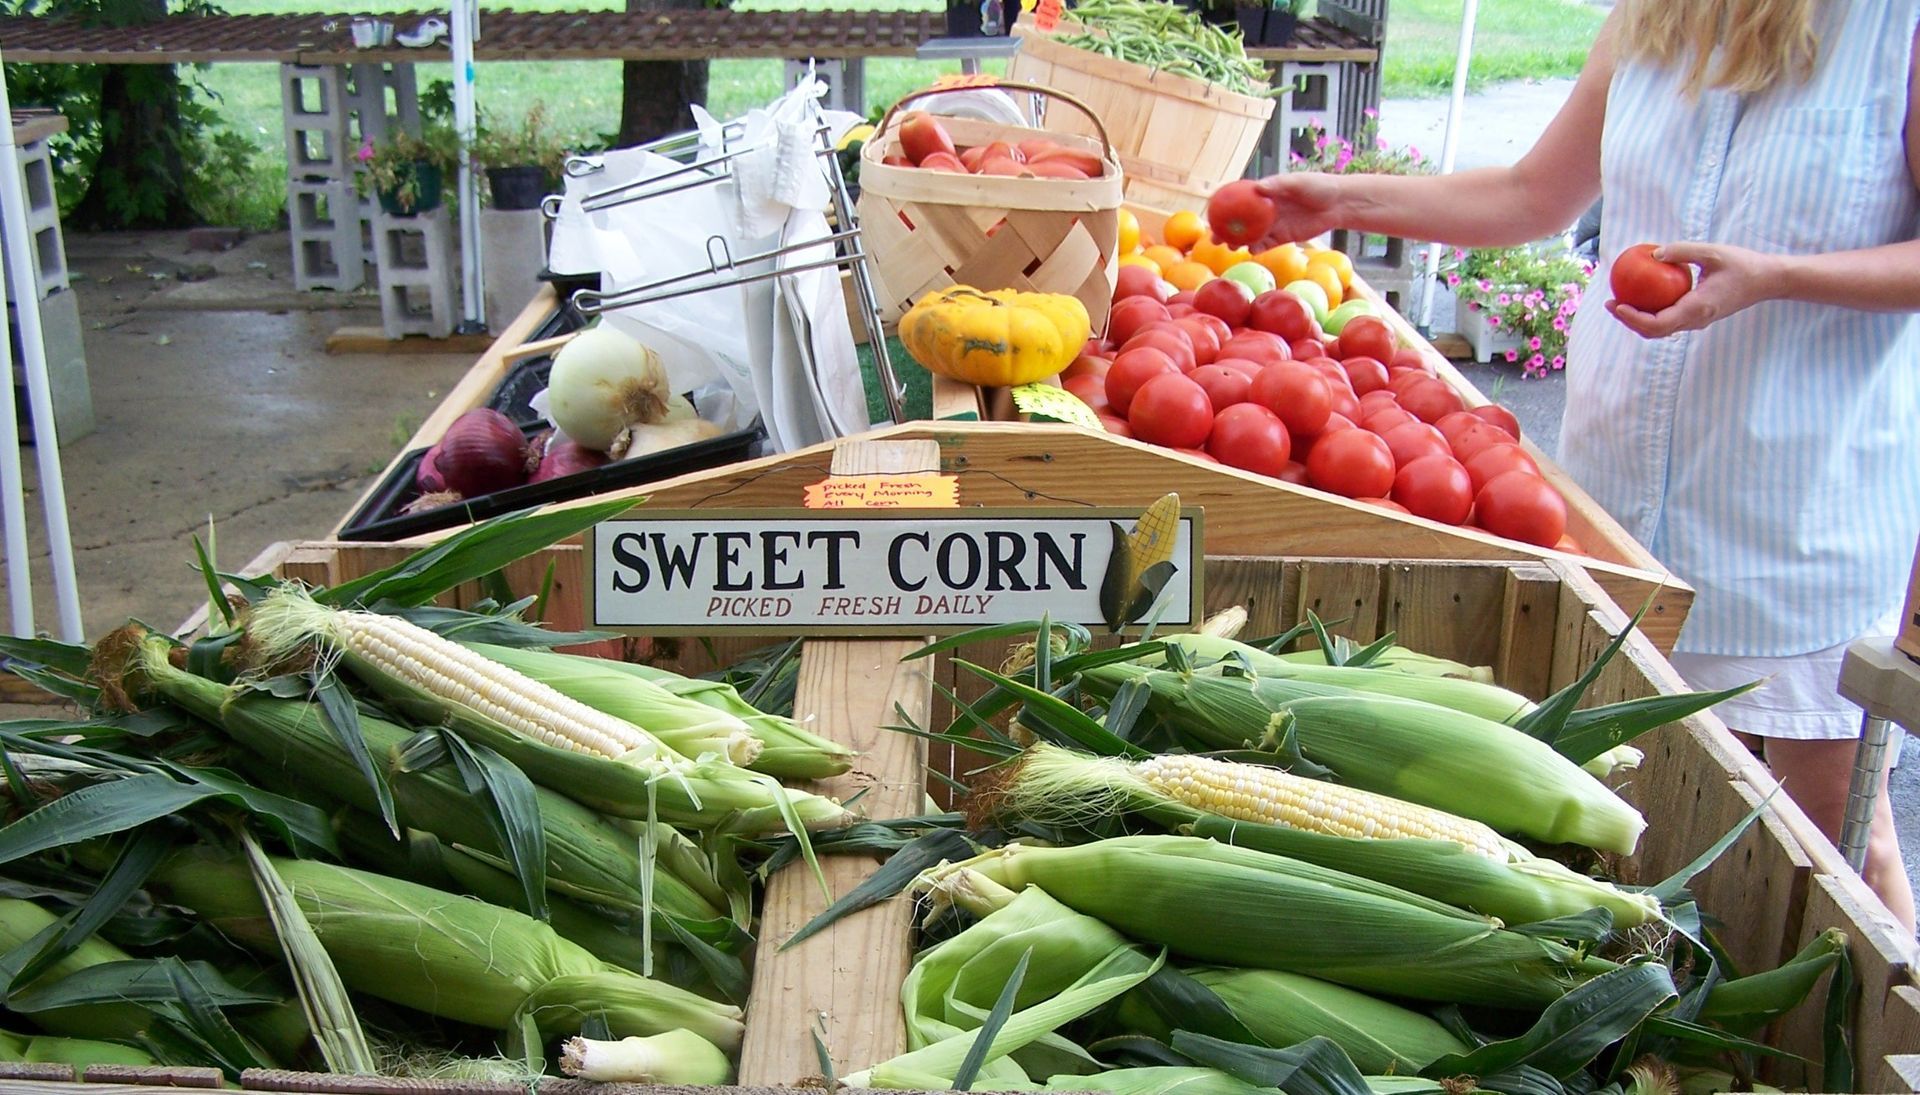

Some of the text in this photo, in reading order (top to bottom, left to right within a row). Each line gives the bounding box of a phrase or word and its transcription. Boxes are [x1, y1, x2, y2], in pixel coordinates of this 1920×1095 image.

[612, 531, 1088, 593] SWEET CORN
[706, 595, 994, 617] PICKED FRESH DAILY
